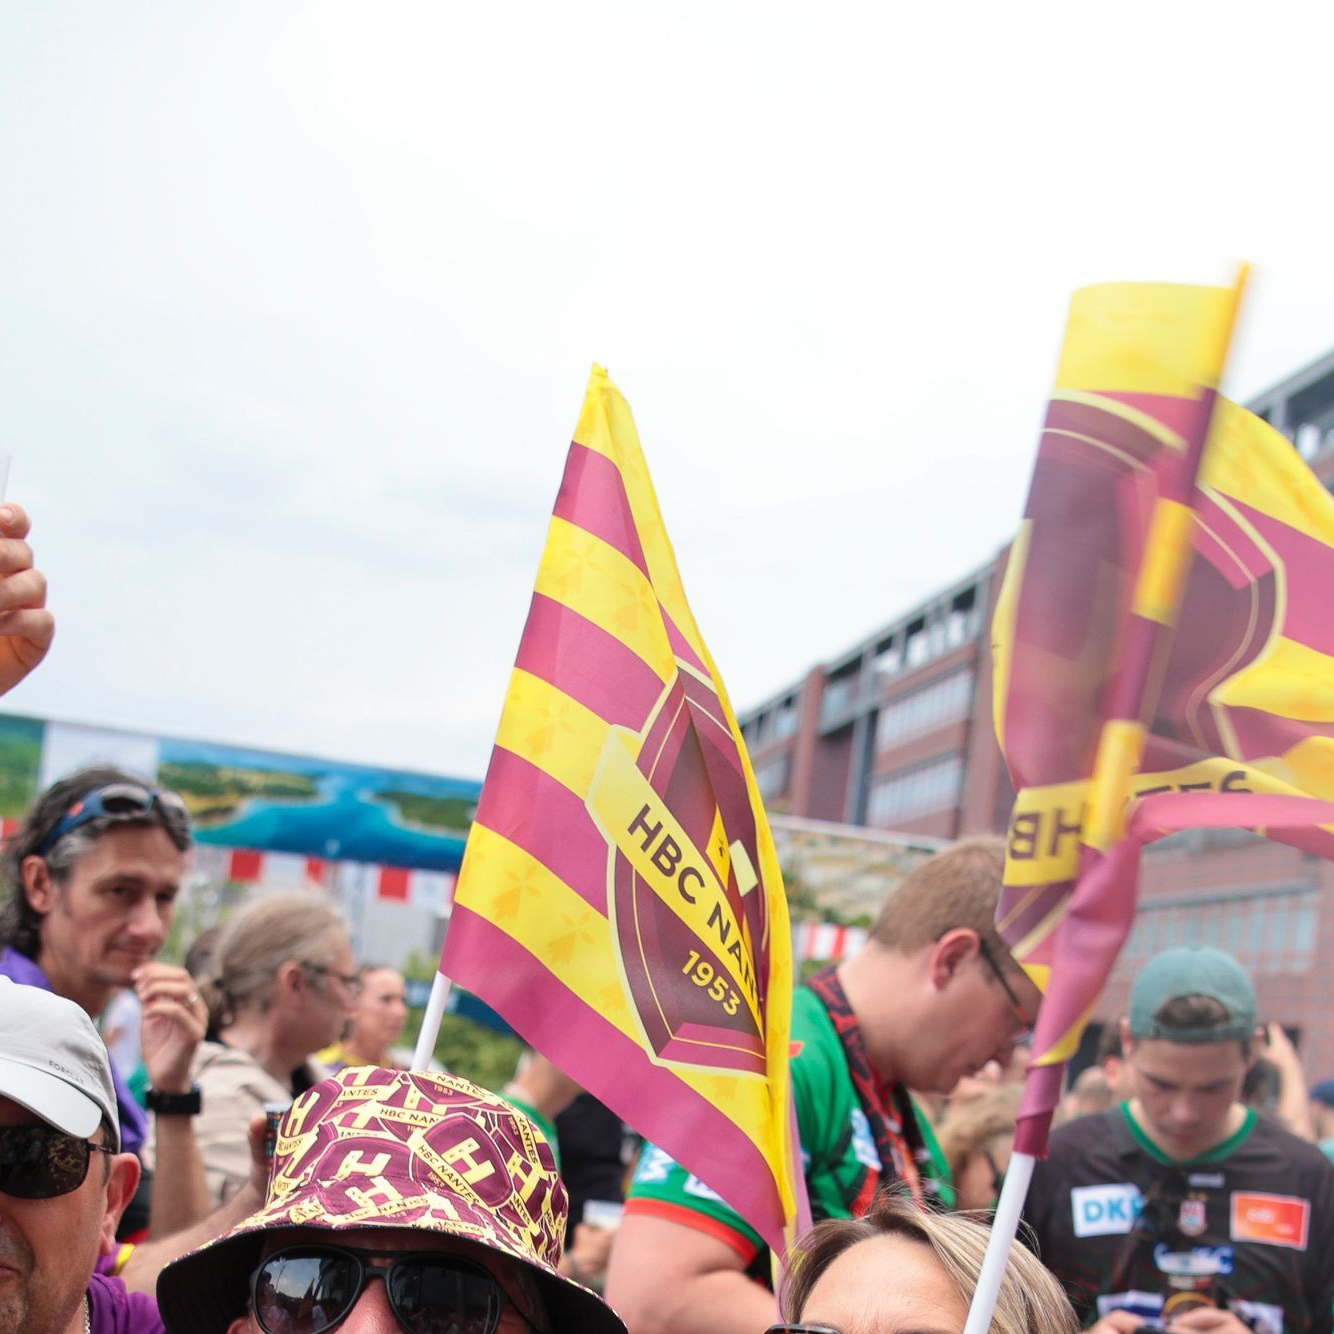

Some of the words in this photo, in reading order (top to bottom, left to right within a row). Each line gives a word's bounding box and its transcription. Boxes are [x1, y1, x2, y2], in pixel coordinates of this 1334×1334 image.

[627, 803, 706, 905] HBC
[707, 901, 759, 1002] NAN
[681, 949, 742, 1016] 1953
[380, 1108, 405, 1119] HBC
[409, 1113, 440, 1124] NAN
[418, 1145, 438, 1166] HBC
[437, 1164, 479, 1203] NANTES
